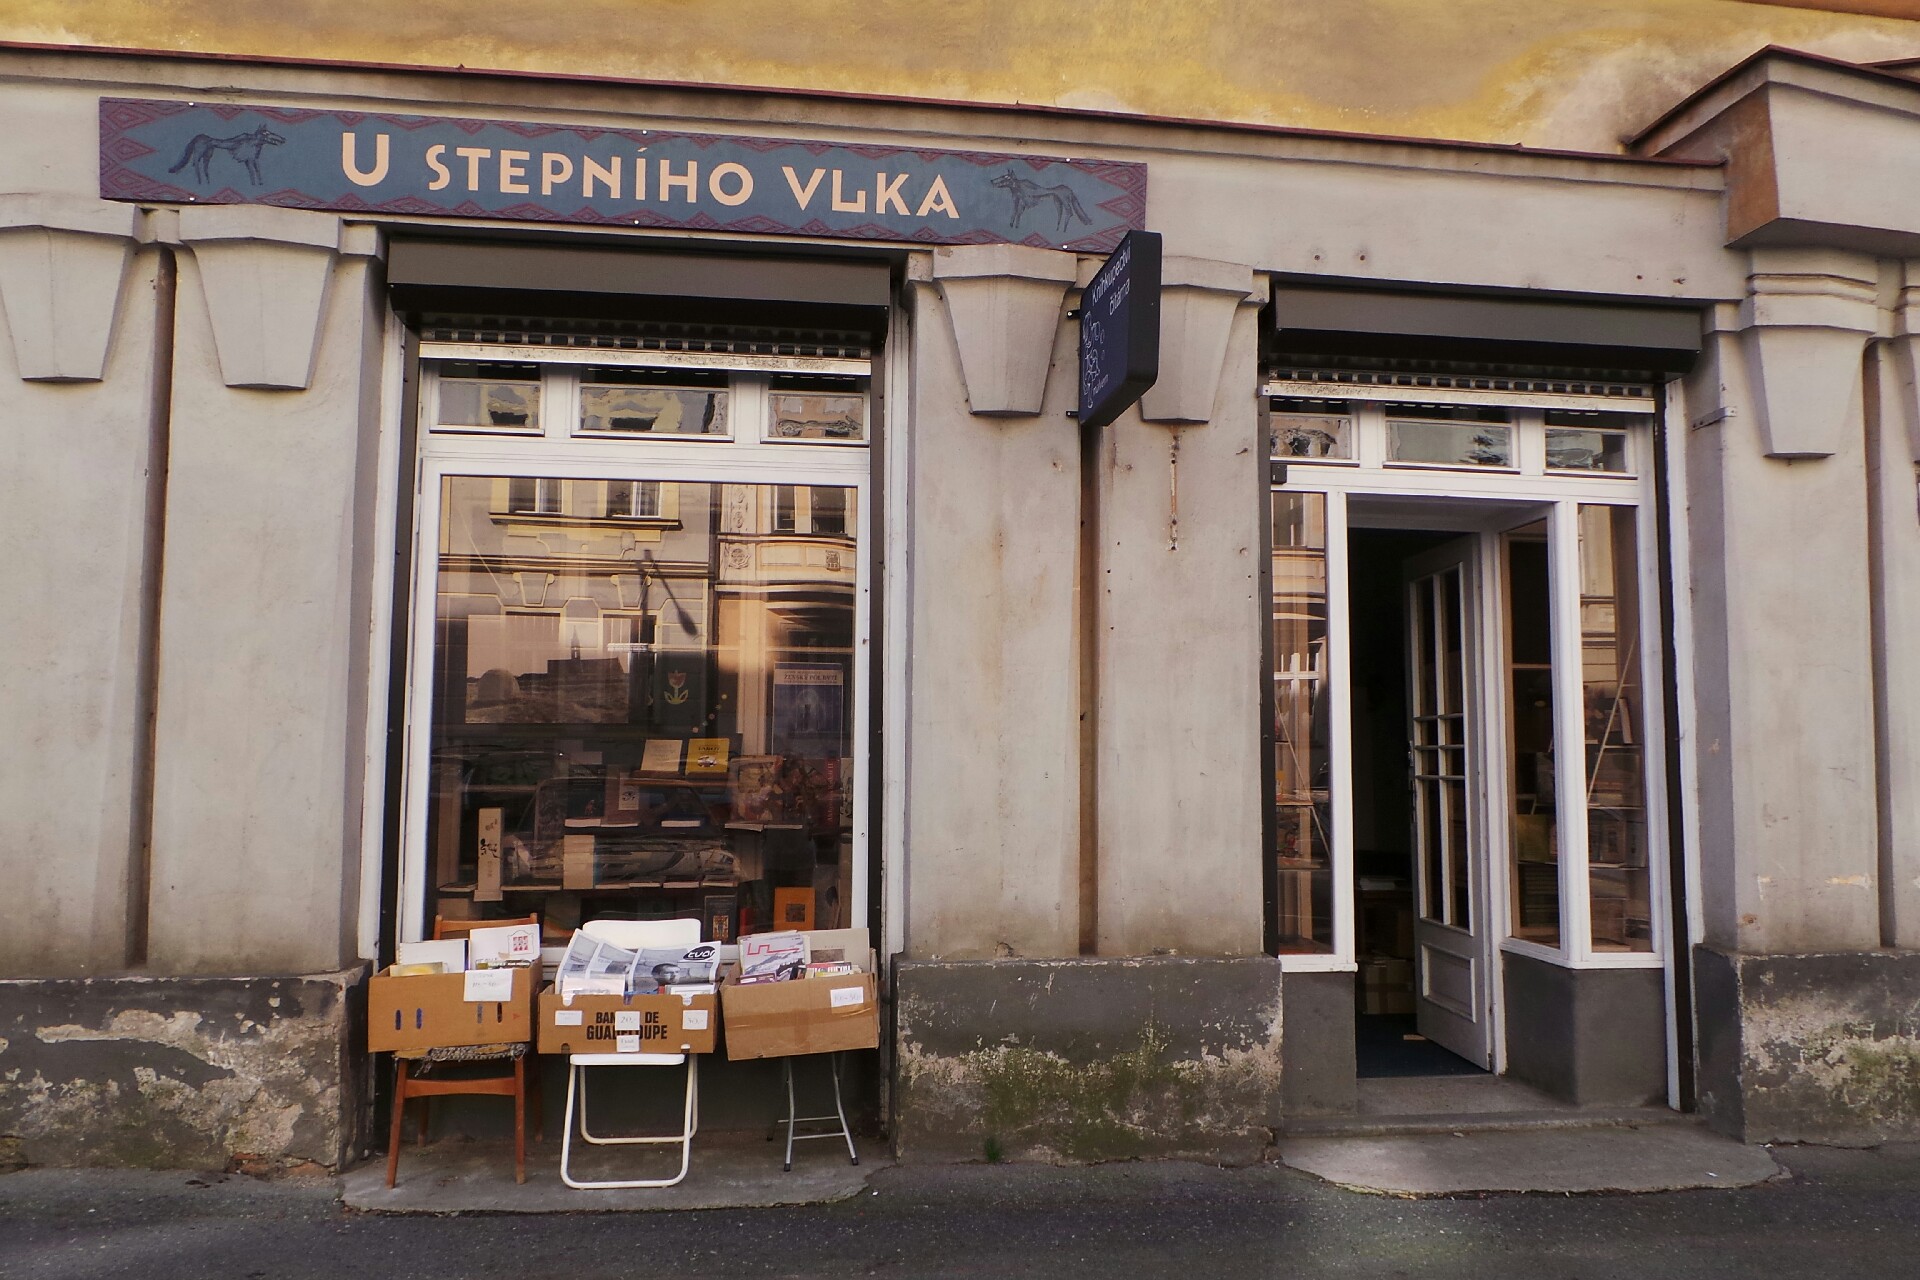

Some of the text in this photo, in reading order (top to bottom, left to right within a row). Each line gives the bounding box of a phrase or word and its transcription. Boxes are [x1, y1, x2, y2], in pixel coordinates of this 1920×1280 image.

[342, 132, 960, 218] U STEPNÍHO VLKA
[645, 1011, 659, 1024] DE
